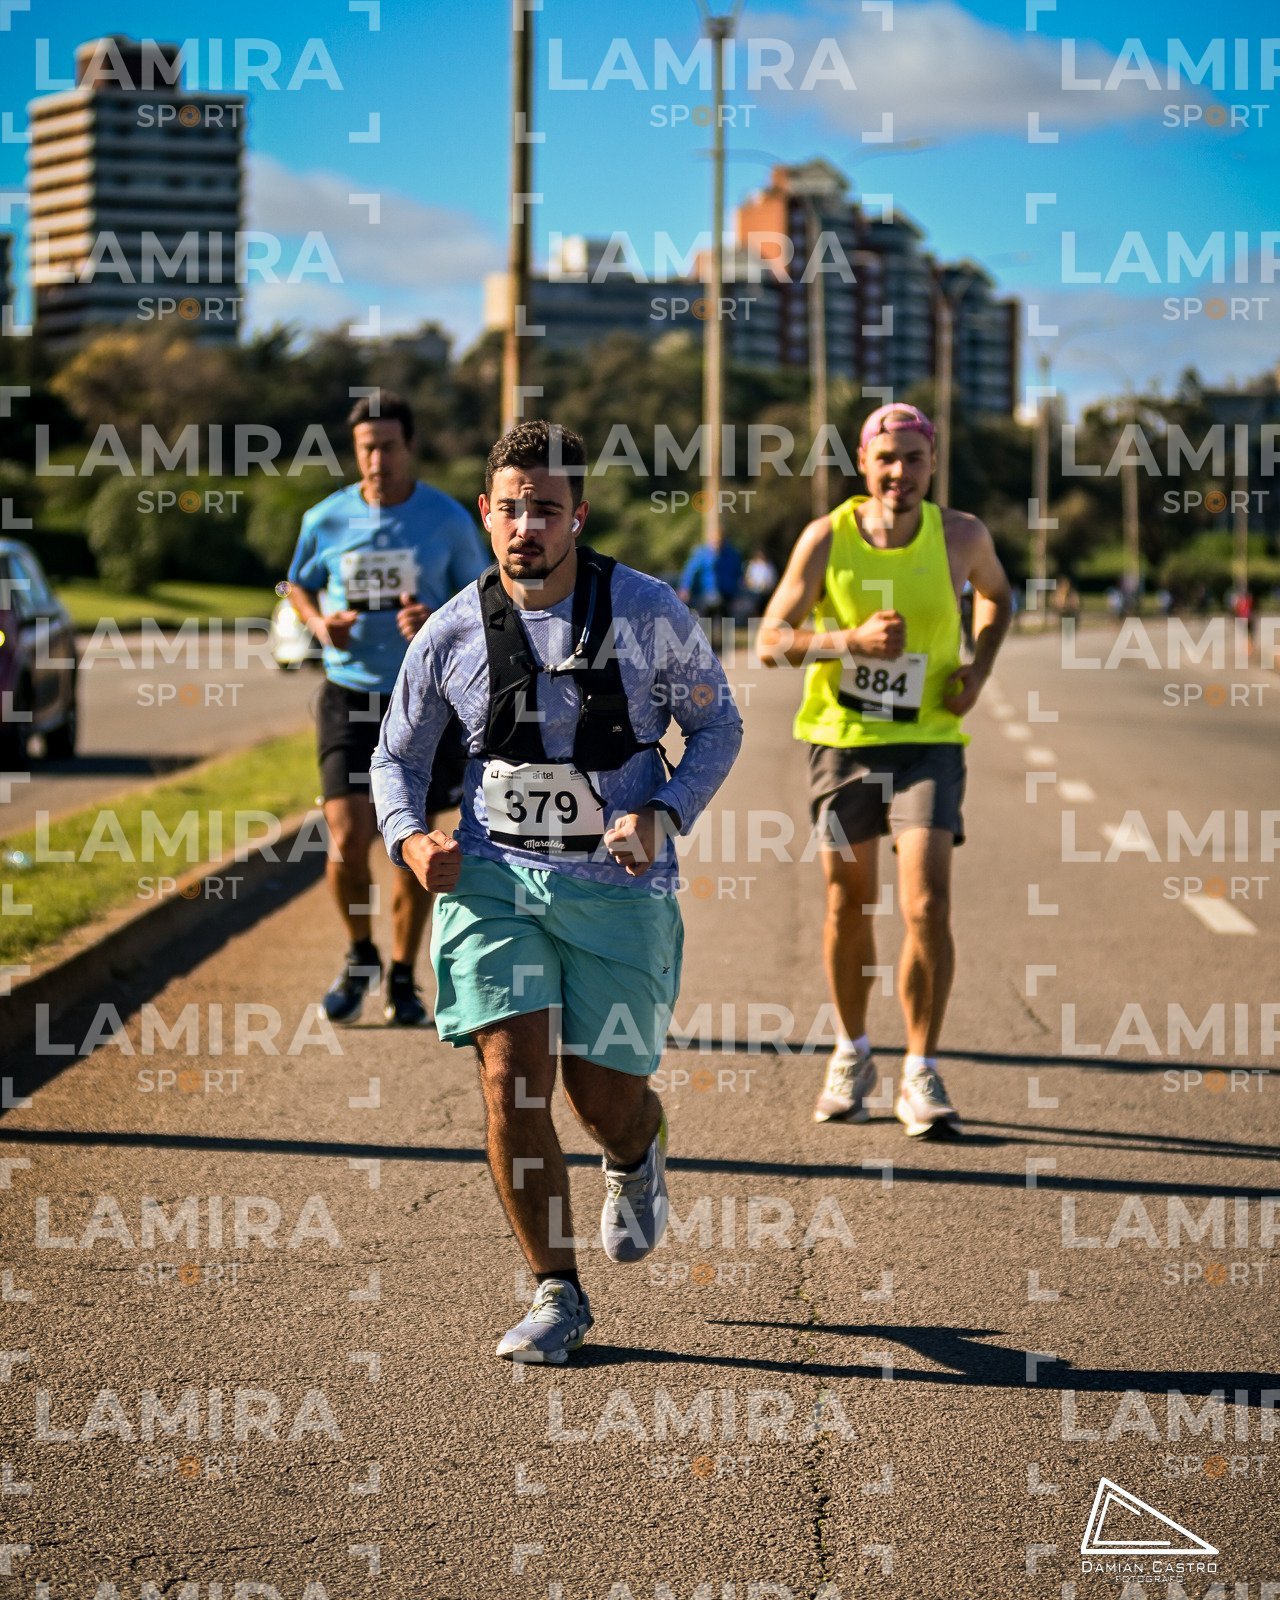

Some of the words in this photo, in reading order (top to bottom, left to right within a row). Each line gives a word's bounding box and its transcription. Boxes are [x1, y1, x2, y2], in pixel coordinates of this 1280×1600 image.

[355, 567, 401, 591] 635
[855, 665, 908, 697] 884
[532, 770, 554, 780] antel
[504, 790, 578, 824] 379
[523, 839, 566, 850] Maratón
